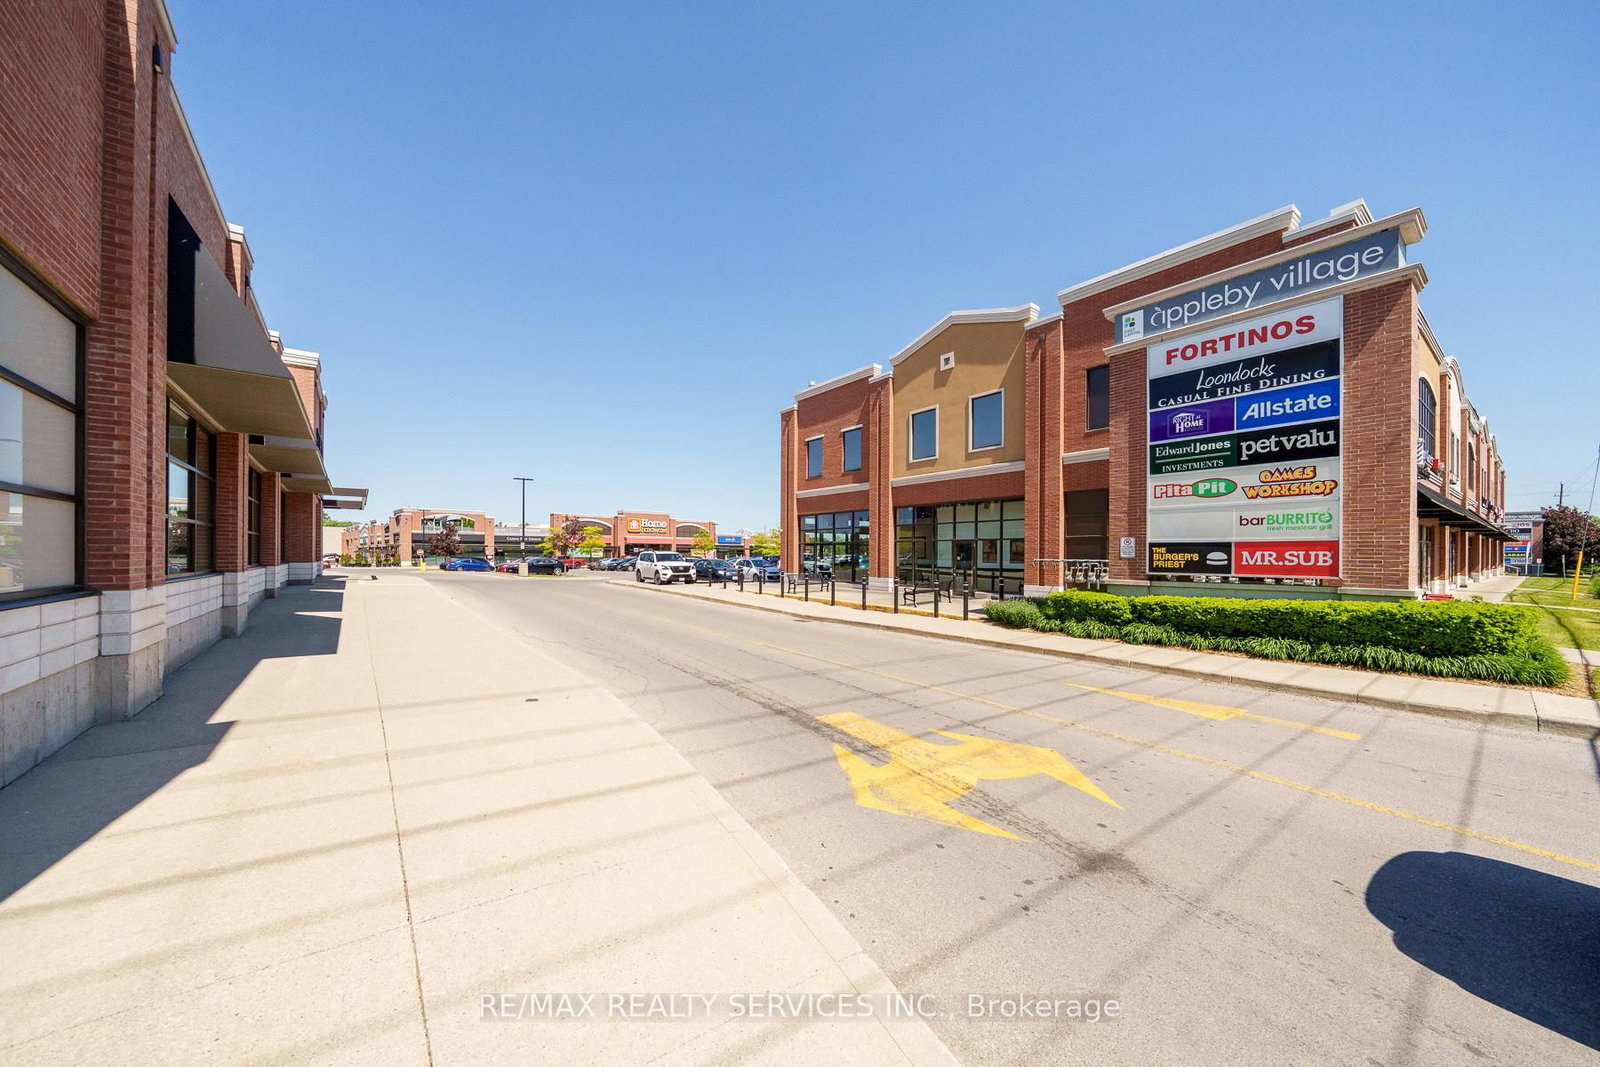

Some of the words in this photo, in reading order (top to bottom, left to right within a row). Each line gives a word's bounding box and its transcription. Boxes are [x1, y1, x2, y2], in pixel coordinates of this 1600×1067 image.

[1150, 280, 1262, 329] appleby
[1270, 245, 1385, 291] village
[1165, 314, 1316, 365] FORTINOS
[1196, 357, 1277, 390] Loondocks
[1158, 391, 1210, 407] CASUAL
[1217, 382, 1252, 396] FINE
[1258, 369, 1327, 389] DINING
[1242, 394, 1332, 421] Allstate
[1175, 418, 1205, 434] HOME
[1162, 459, 1224, 472] INVESTMENTS
[1259, 466, 1317, 482] GAMES
[1154, 483, 1194, 498] Pita
[1198, 481, 1228, 495] Pit
[1242, 480, 1338, 499] WORKSHOP
[641, 519, 668, 528] Home
[1153, 553, 1199, 561] BURGER'S
[1153, 560, 1186, 568] PRIEST
